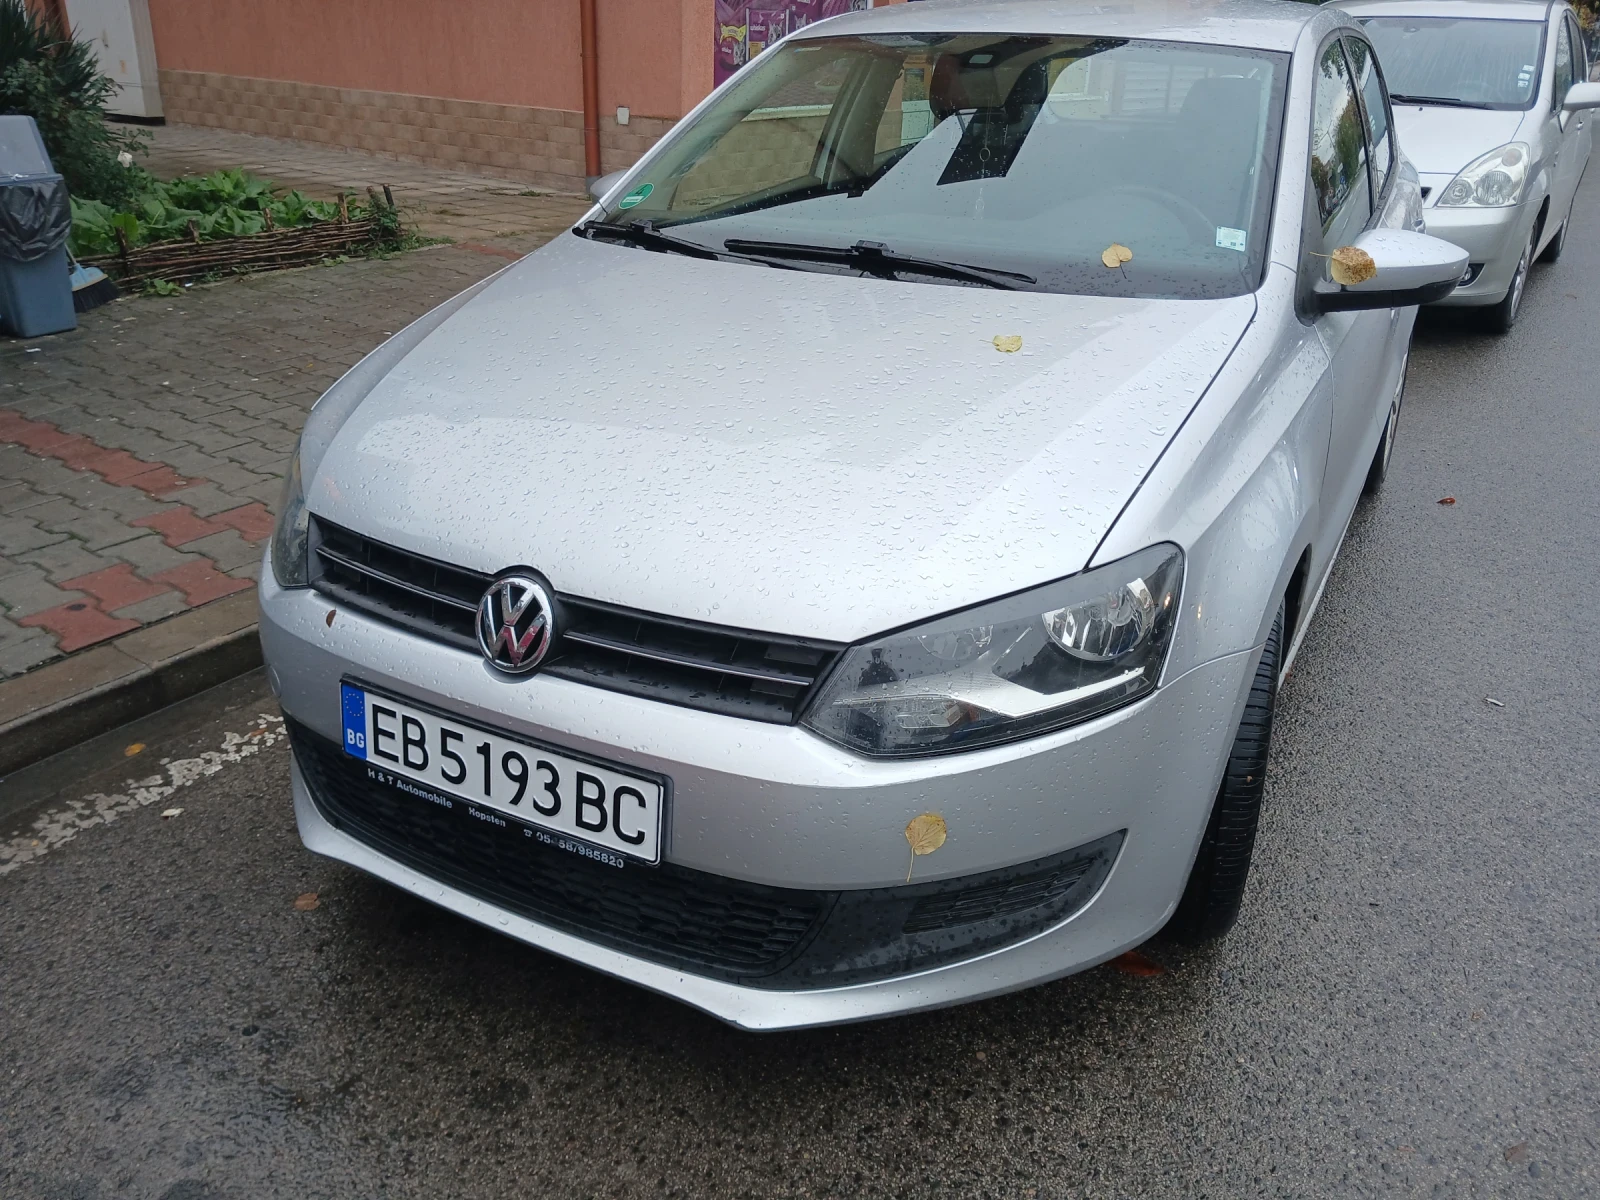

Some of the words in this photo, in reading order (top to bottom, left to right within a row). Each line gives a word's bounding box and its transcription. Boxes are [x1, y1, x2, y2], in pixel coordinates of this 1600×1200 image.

[347, 728, 365, 749] BG
[367, 768, 376, 779] H
[378, 772, 385, 783] &
[387, 775, 394, 785] T
[396, 780, 453, 809] Automobile
[468, 806, 506, 828] Hopsten
